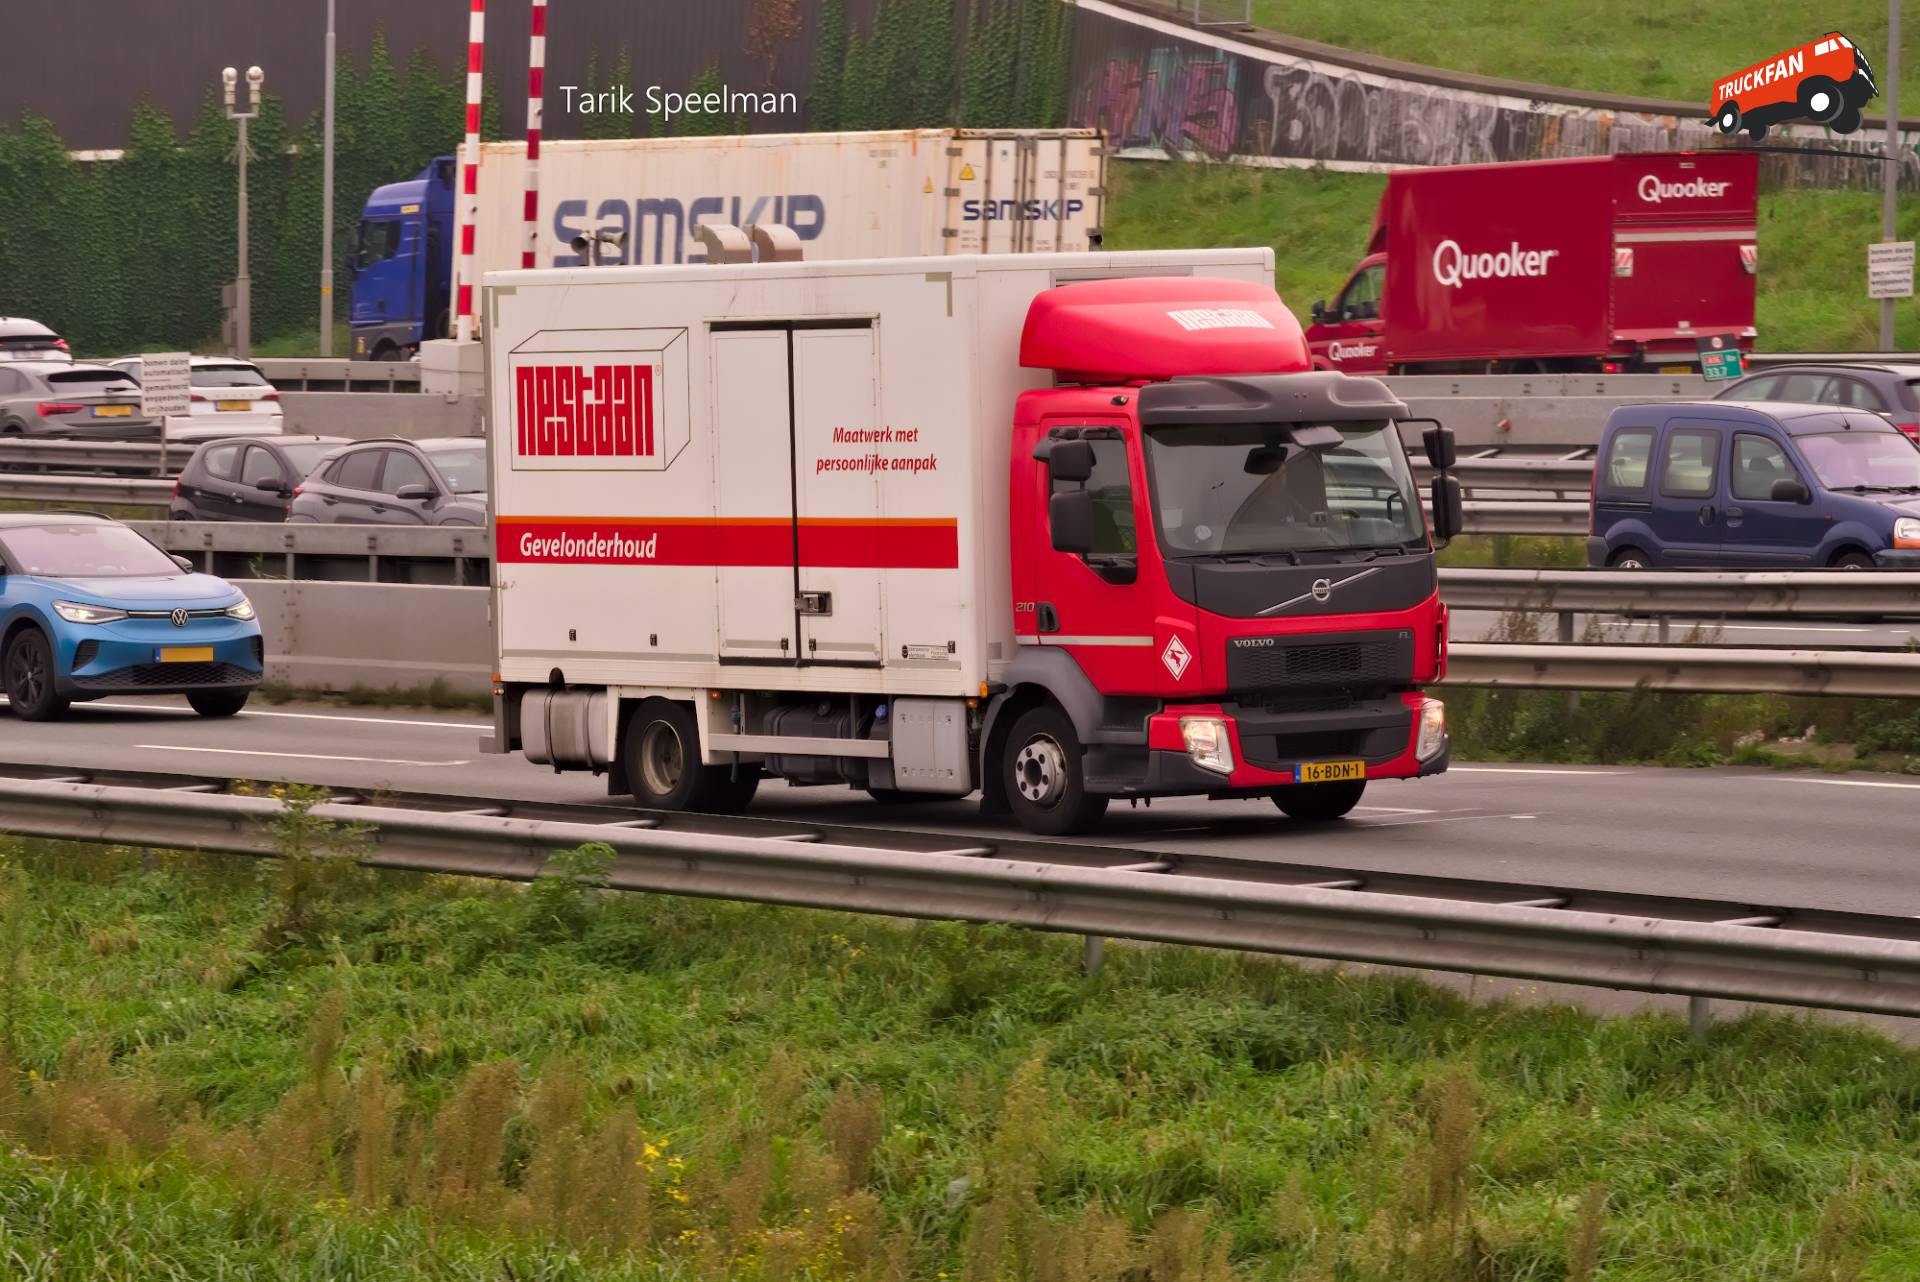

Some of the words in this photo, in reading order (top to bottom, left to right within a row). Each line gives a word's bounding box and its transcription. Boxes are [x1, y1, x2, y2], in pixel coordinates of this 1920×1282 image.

[1638, 174, 1731, 203] Quooker
[1433, 239, 1558, 289] Quooker
[1328, 342, 1378, 361] Quooker
[516, 364, 655, 456] nestaan
[833, 426, 893, 443] Maatwerk
[895, 428, 919, 442] met
[816, 454, 889, 475] persoonlijke
[891, 453, 937, 475] aanpak
[520, 531, 657, 559] Gevelonderhoud
[1015, 602, 1035, 613] 210
[1233, 638, 1275, 648] VOLVO
[1307, 763, 1359, 779] 16-BDN-1
